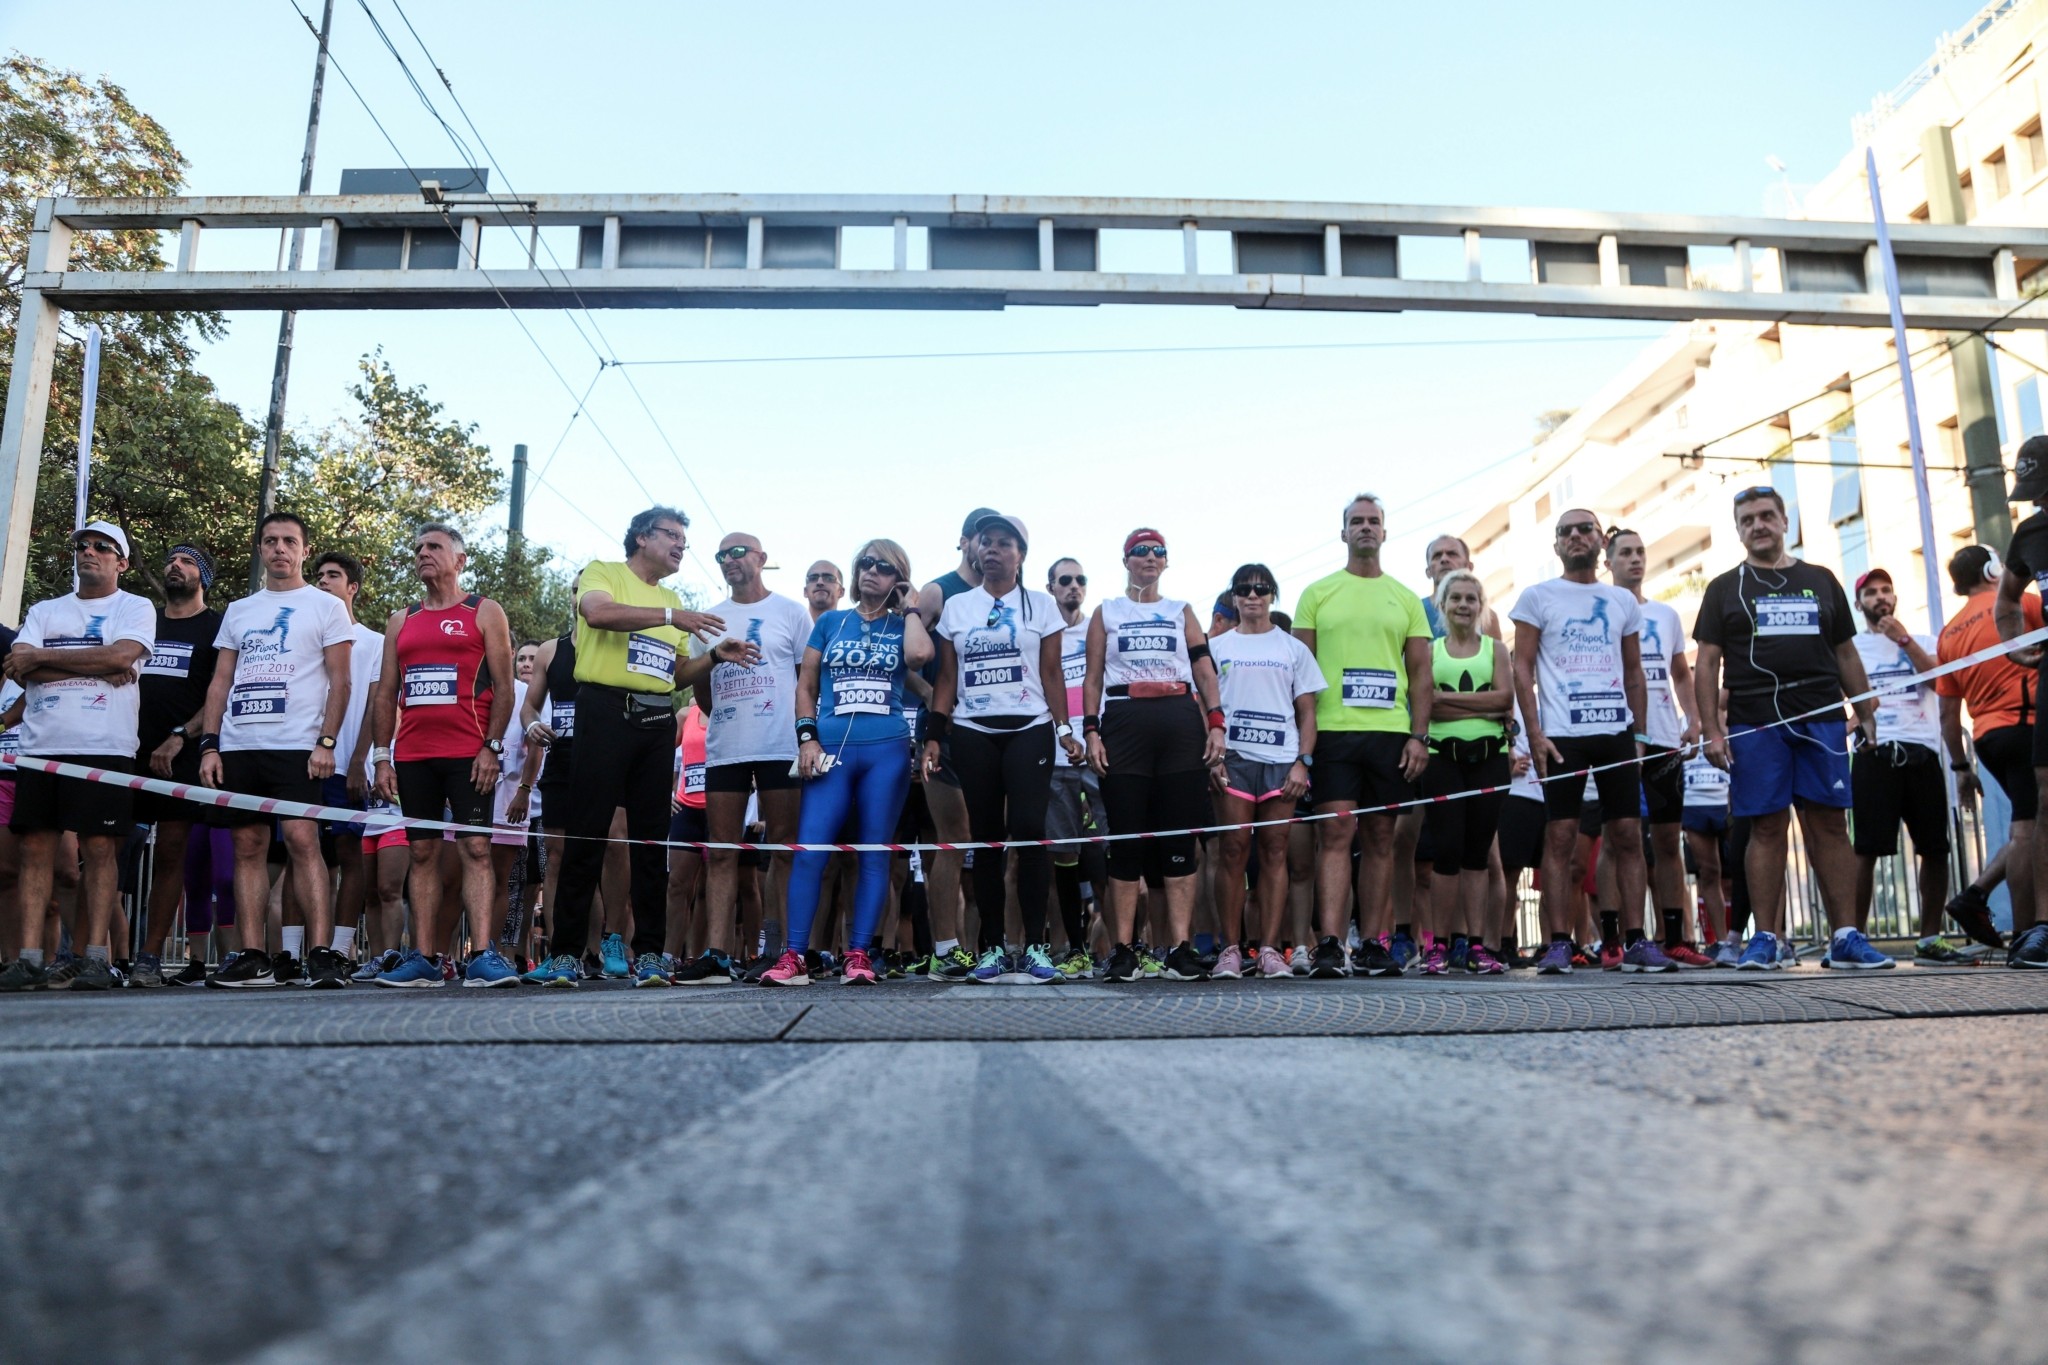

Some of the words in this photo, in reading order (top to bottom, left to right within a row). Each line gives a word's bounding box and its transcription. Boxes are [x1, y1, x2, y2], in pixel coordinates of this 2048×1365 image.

[832, 640, 899, 654] ATHENS
[1127, 637, 1168, 650] 20262
[1570, 643, 1603, 653] Αθήνας
[149, 655, 178, 667] 25313
[244, 653, 278, 665] Αθήνας
[1234, 660, 1288, 671] Praxiabank
[269, 663, 295, 673] 2019
[723, 667, 756, 679] Αθήνας
[974, 668, 1013, 685] 20101
[410, 681, 449, 696] 20598
[725, 679, 748, 691] ΣΕΠΤ.
[752, 676, 775, 686] 2019
[839, 690, 885, 705] 20090
[1351, 685, 1389, 699] 20734
[240, 700, 273, 714] 25353
[641, 713, 671, 723] SALOMON
[1237, 727, 1277, 744] 25296
